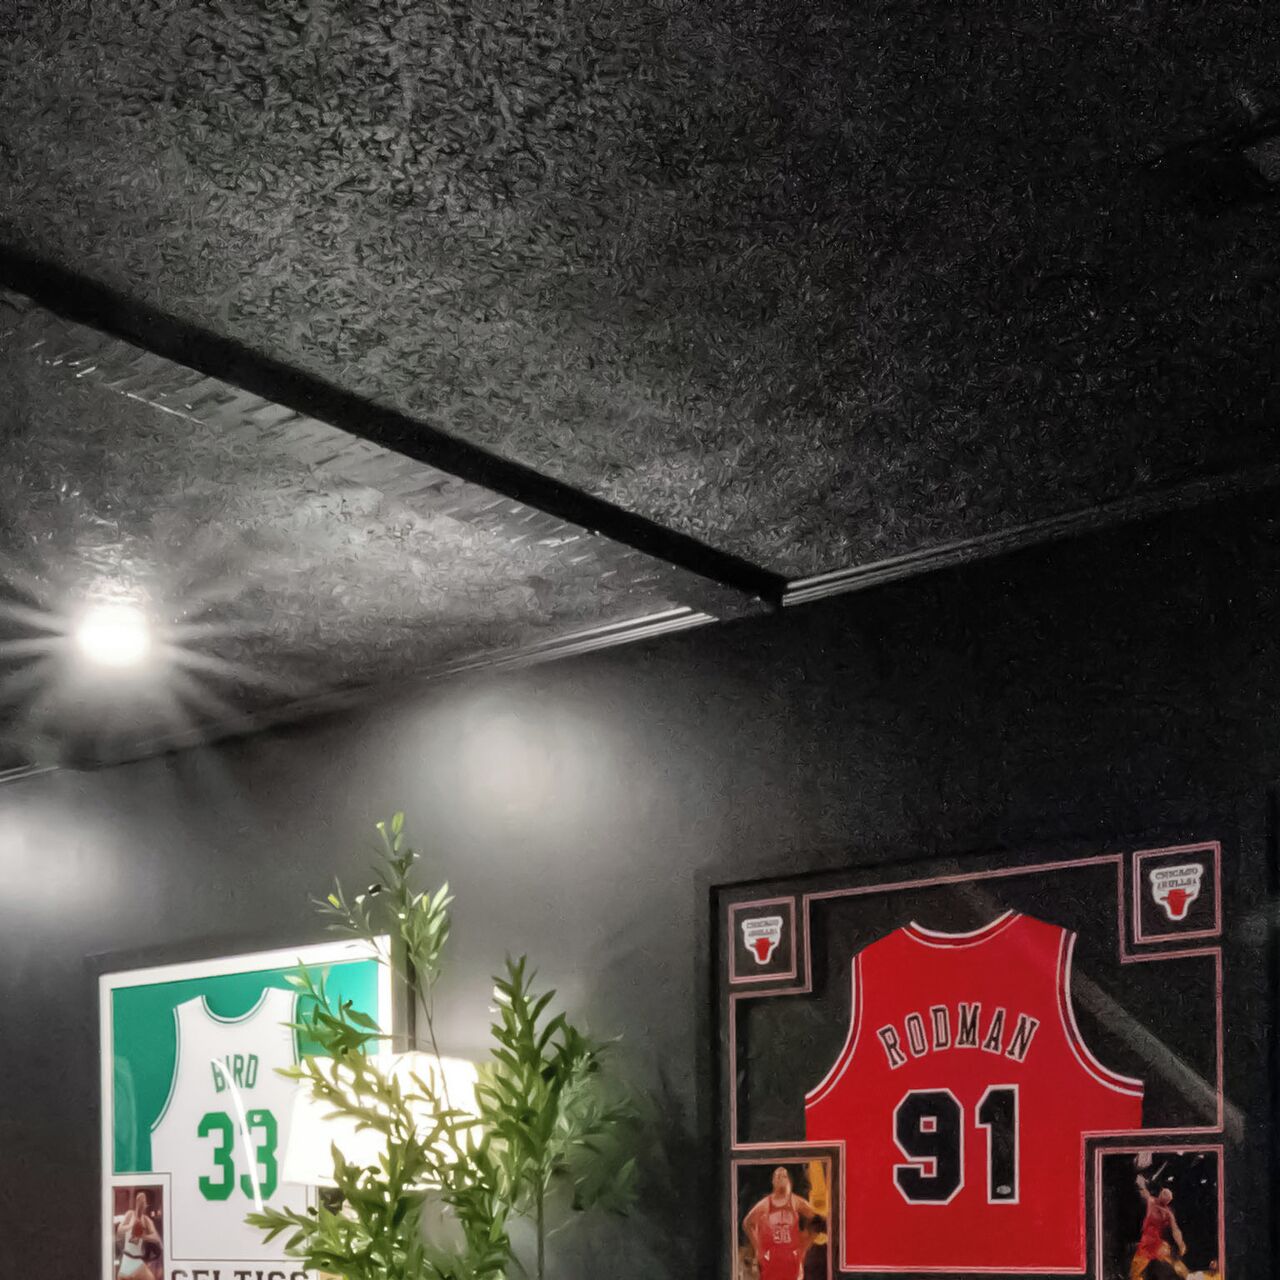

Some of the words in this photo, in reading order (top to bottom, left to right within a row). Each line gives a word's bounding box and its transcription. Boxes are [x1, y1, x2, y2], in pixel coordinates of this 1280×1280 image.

[211, 1053, 259, 1093] BIRD
[876, 1002, 1040, 1070] RODMAN
[197, 1109, 279, 1201] 33
[893, 1083, 1020, 1206] 91
